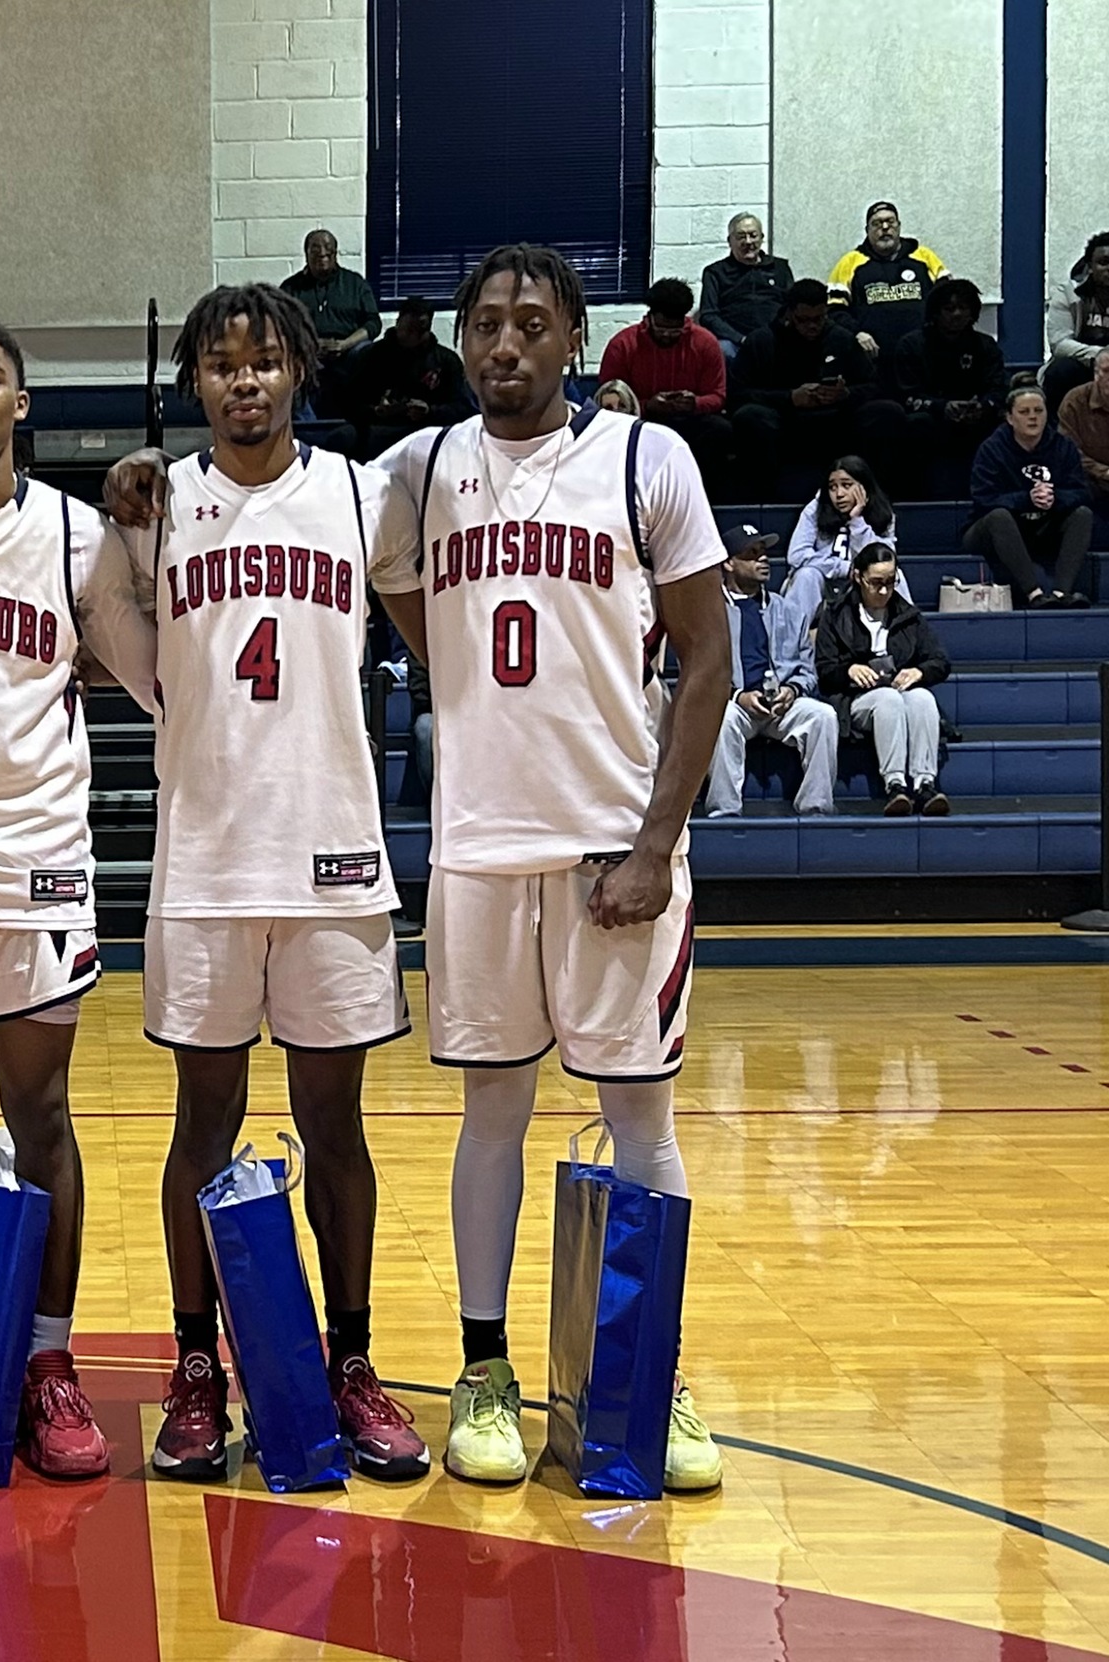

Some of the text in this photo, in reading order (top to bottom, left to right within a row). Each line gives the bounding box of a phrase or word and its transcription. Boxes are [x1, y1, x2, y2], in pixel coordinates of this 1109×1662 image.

[167, 545, 353, 620] LOUISBURG
[432, 520, 613, 596] LOUISBURG
[236, 617, 280, 701] 4
[493, 600, 536, 687] 0
